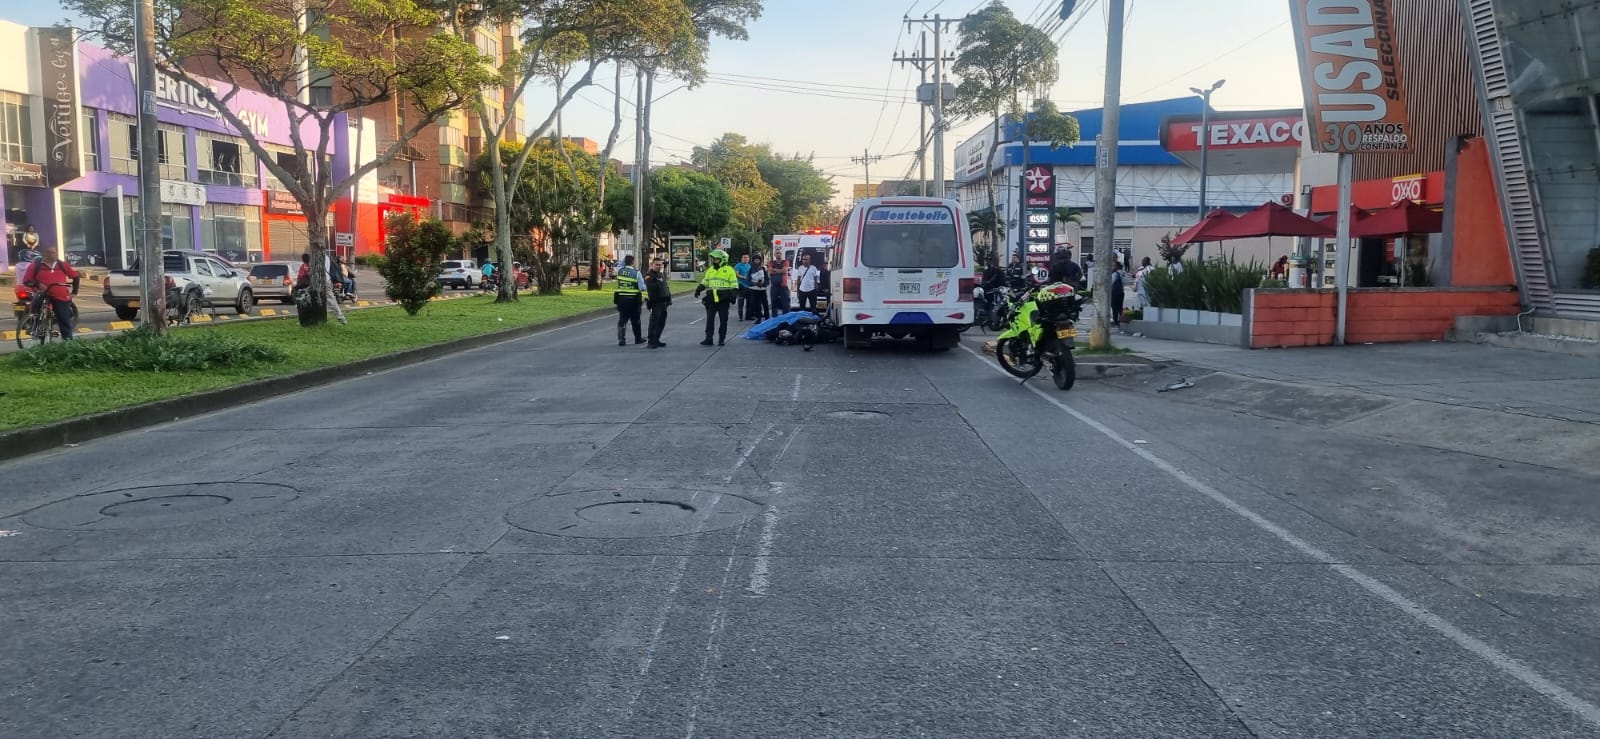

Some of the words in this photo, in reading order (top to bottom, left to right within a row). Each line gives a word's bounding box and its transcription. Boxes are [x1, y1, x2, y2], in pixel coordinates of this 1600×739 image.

[1306, 0, 1387, 122] USAD
[1322, 123, 1361, 151] 30
[1363, 120, 1404, 134] AÑOS
[1360, 142, 1409, 151] CONFIANZA
[1362, 134, 1408, 143] RESPALDO
[1392, 180, 1421, 202] OXXO
